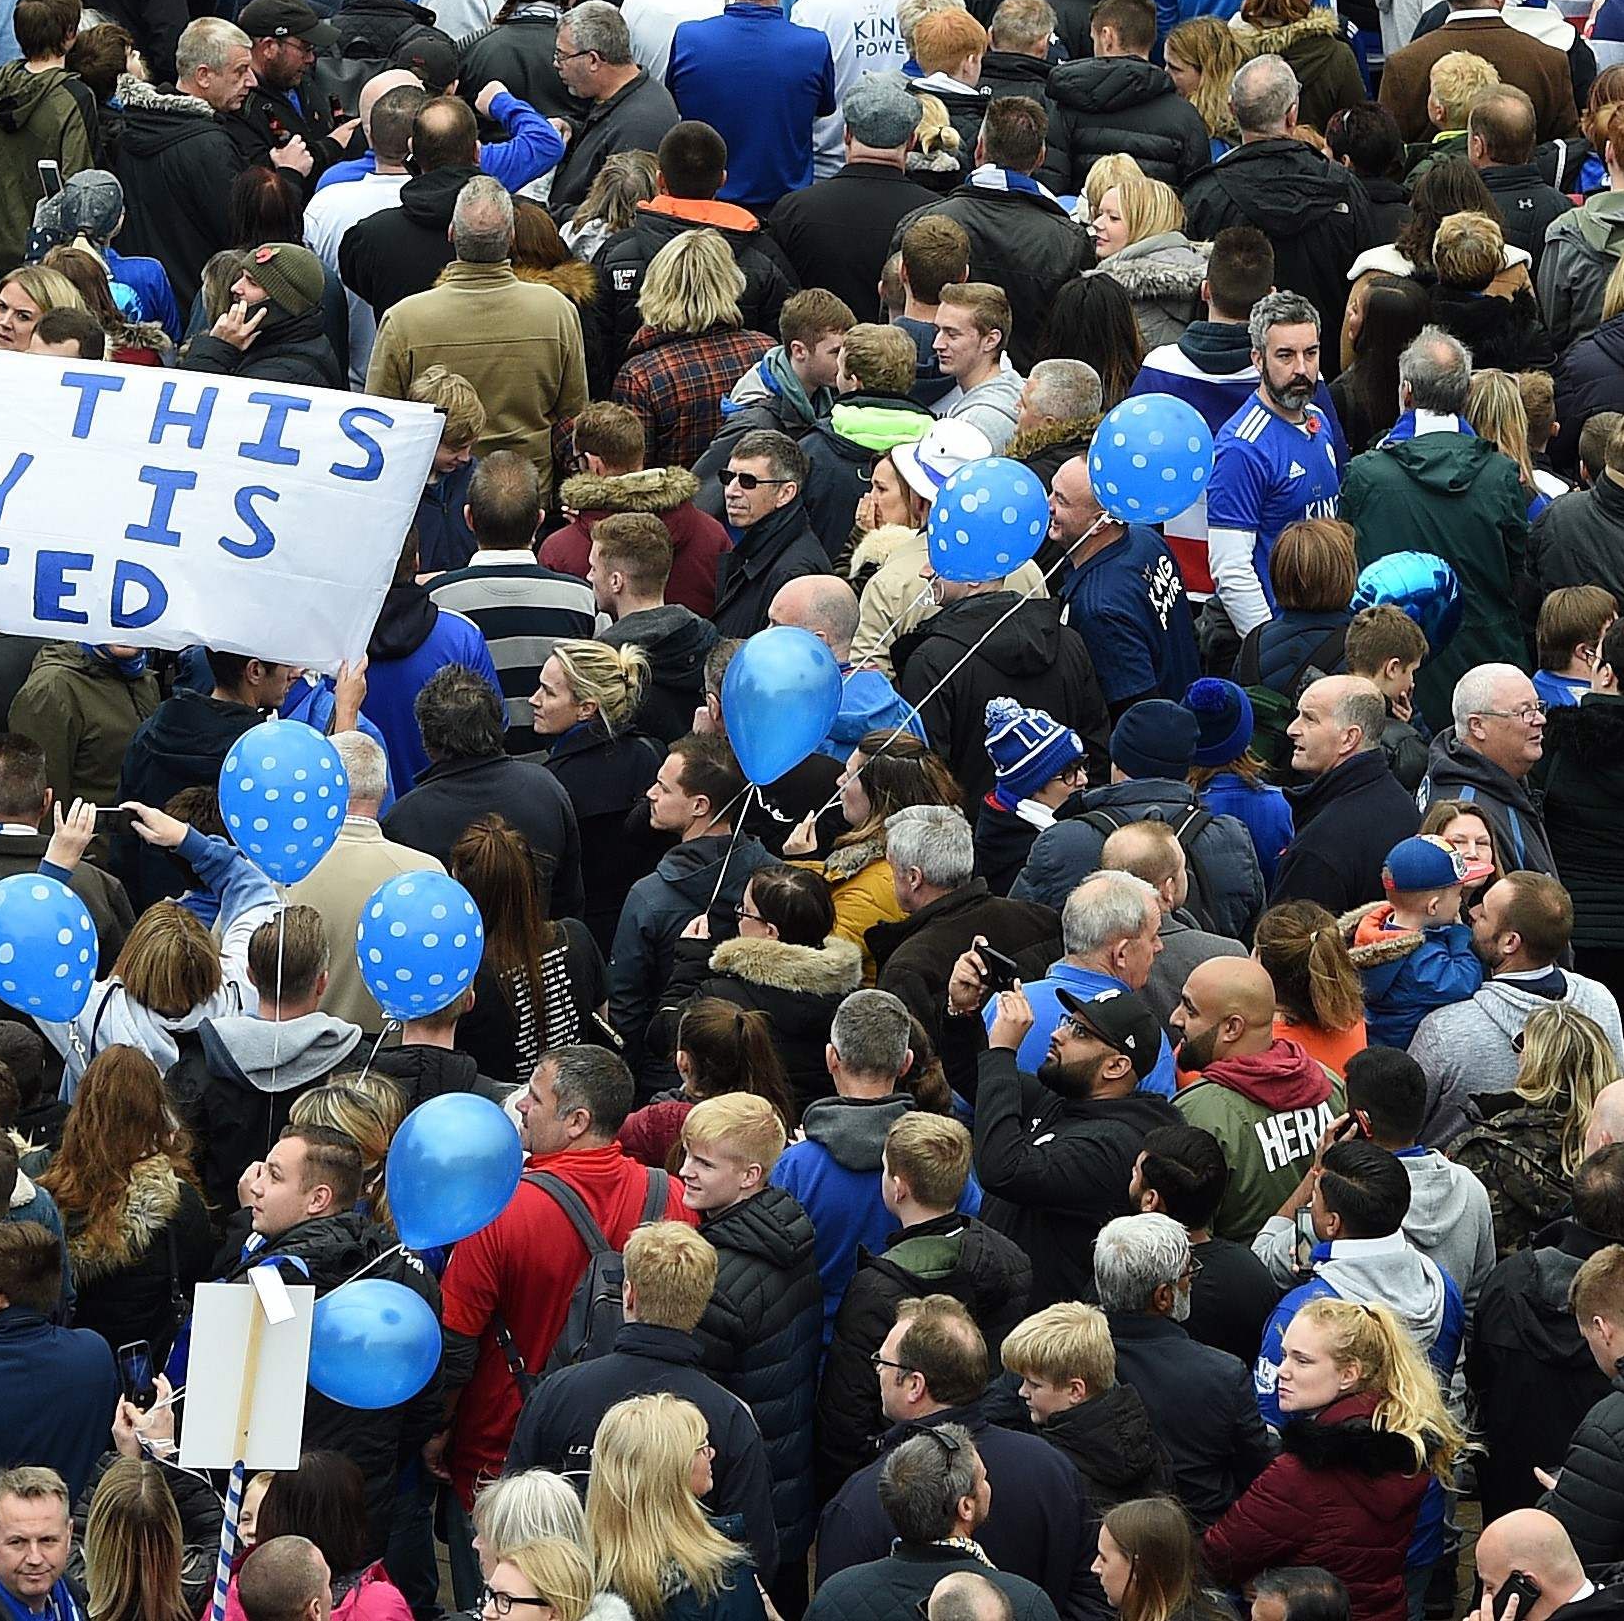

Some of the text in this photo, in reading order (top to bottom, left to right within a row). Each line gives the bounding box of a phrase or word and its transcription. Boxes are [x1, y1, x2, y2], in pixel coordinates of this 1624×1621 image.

[854, 17, 895, 42] KIN
[855, 40, 906, 58] POWE
[61, 371, 395, 482] THIS
[125, 466, 281, 560] IS
